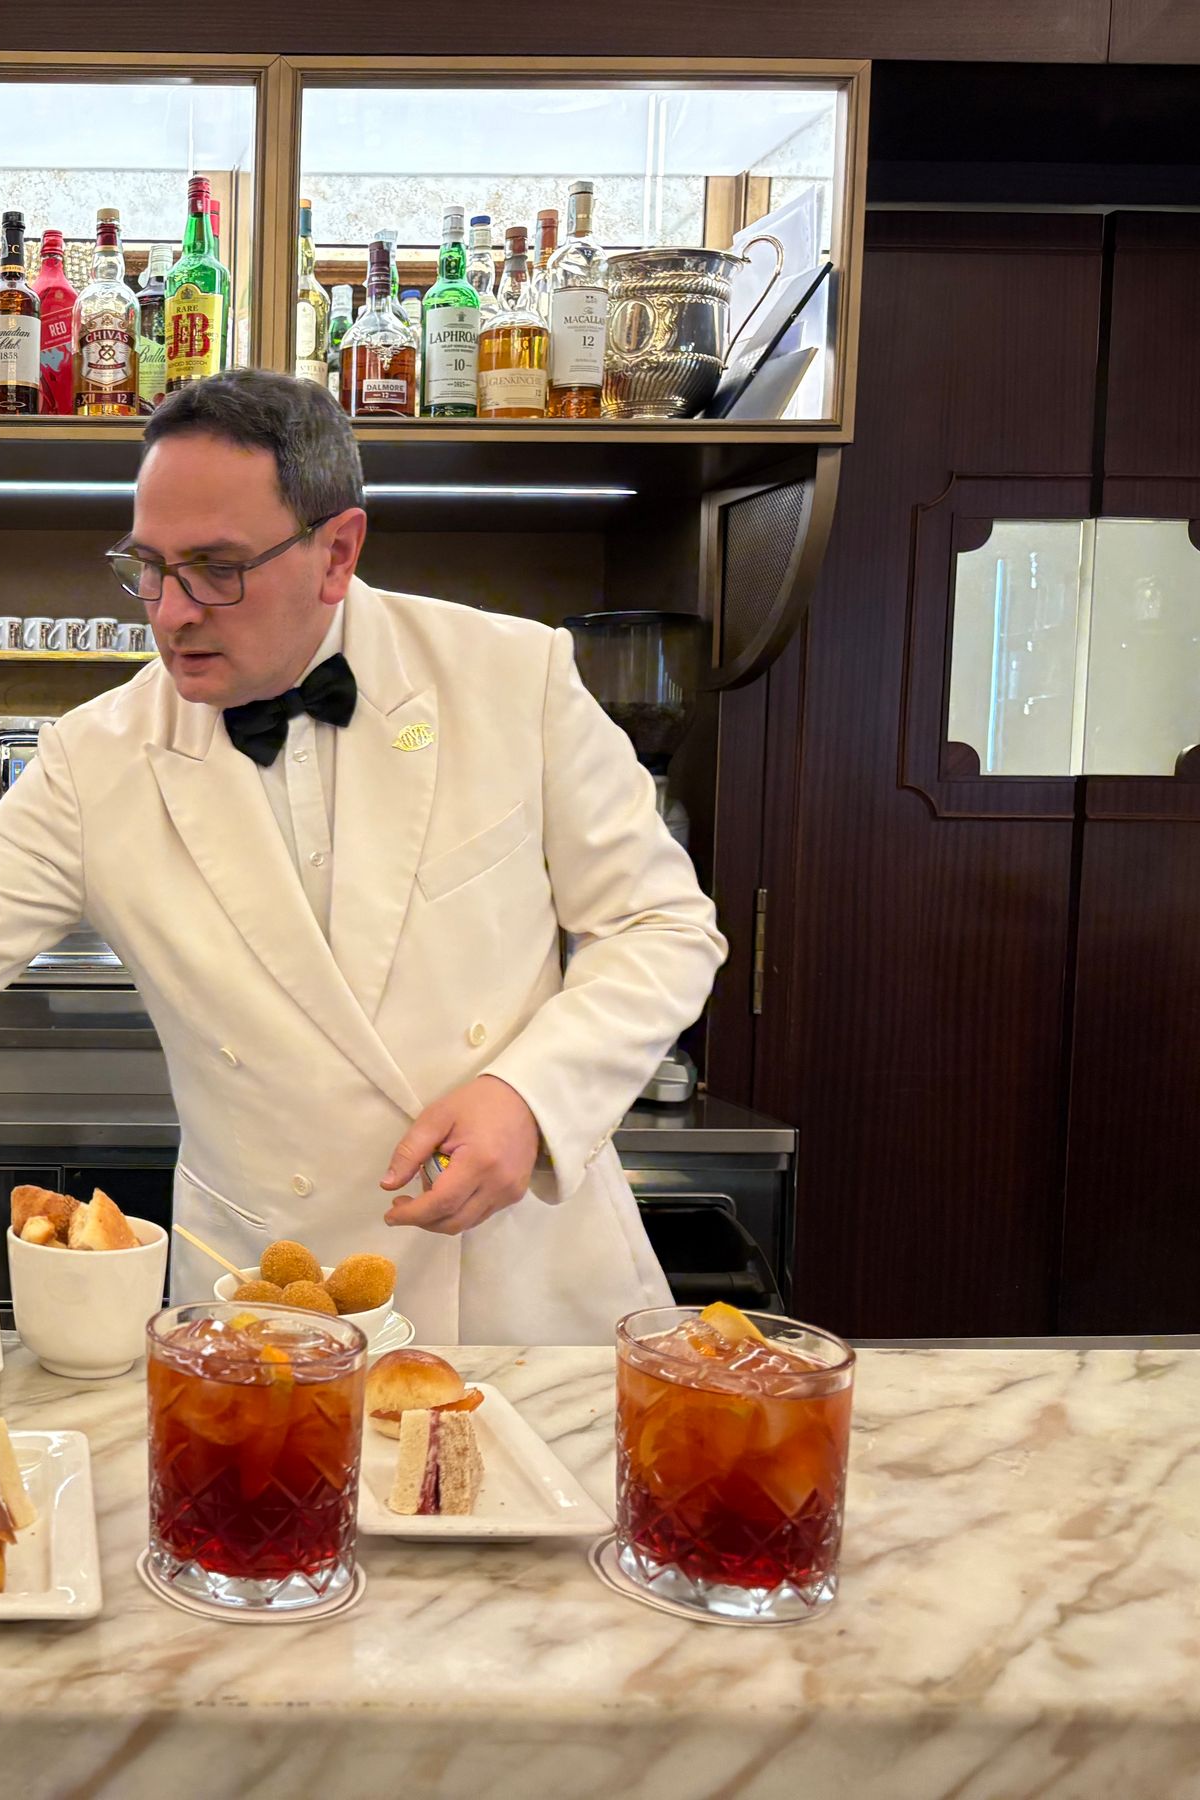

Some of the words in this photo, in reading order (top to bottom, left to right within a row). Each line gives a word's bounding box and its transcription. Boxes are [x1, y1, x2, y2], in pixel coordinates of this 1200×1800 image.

[176, 305, 199, 313] RARE
[48, 321, 67, 337] RED
[85, 330, 129, 343] CHIVAS
[582, 335, 595, 347] 12
[0, 352, 18, 360] 1858
[139, 345, 166, 364] Balla
[453, 358, 466, 371] 10
[366, 384, 404, 392] DALMORE
[81, 393, 96, 404] XII
[117, 393, 128, 403] 12
